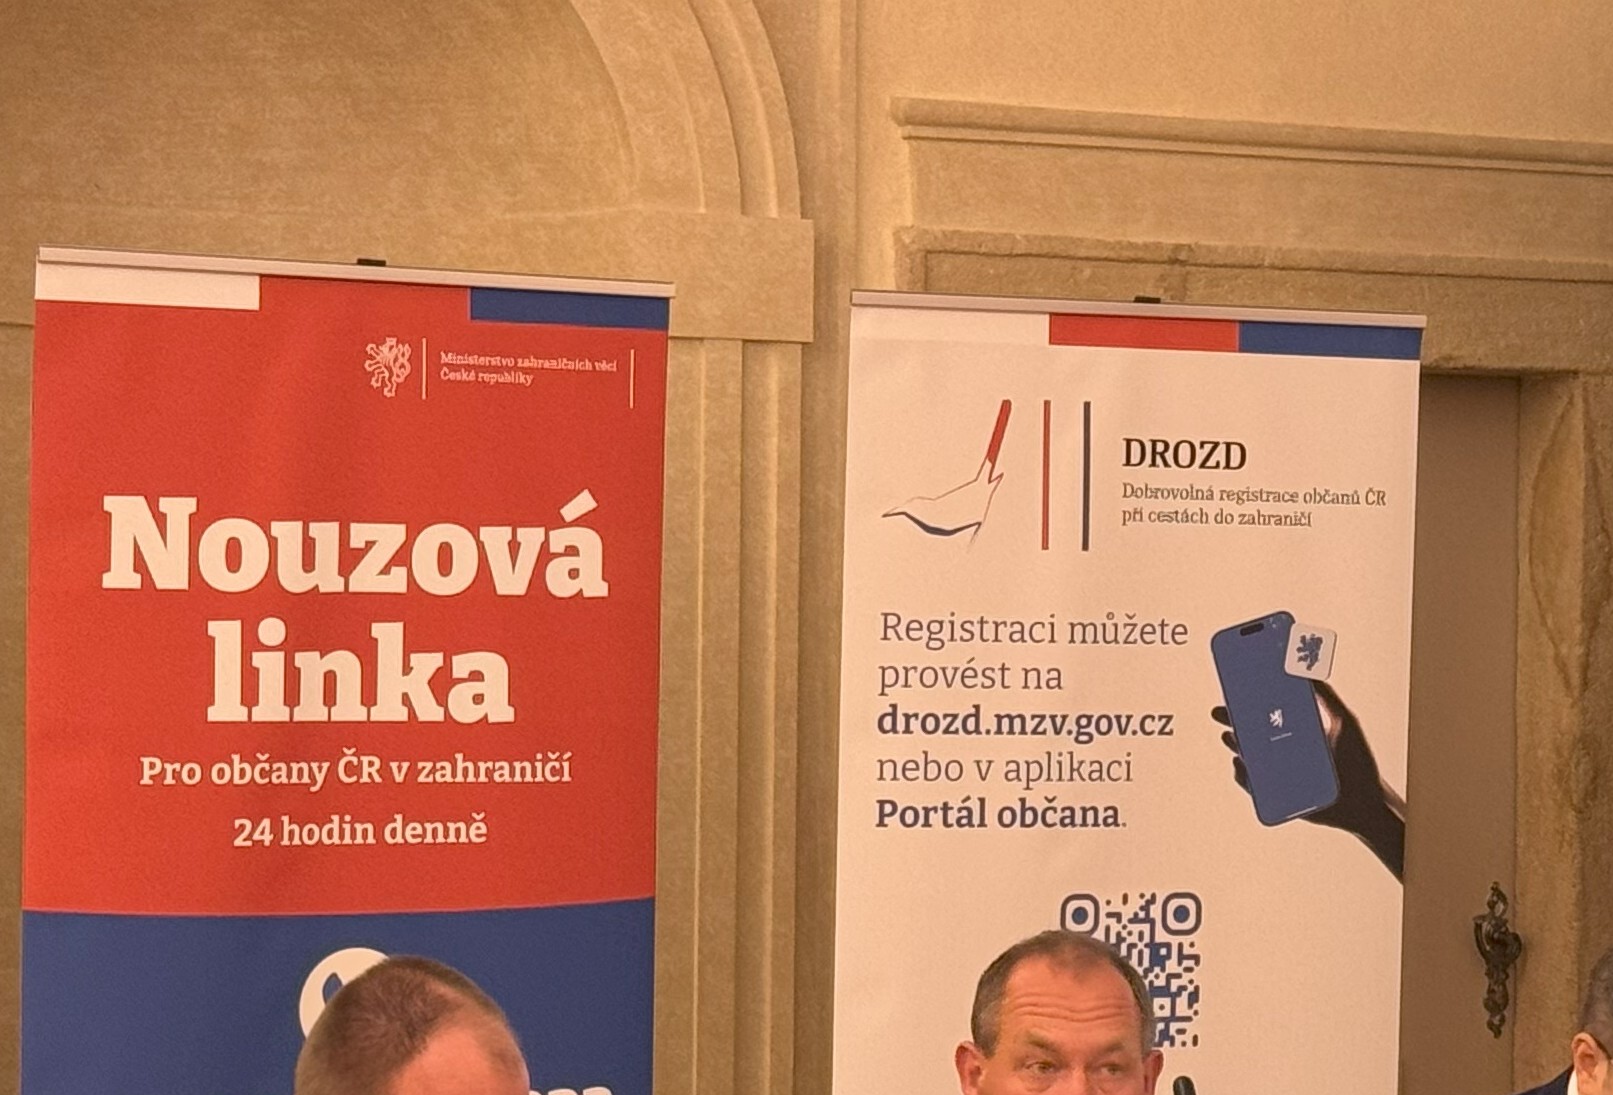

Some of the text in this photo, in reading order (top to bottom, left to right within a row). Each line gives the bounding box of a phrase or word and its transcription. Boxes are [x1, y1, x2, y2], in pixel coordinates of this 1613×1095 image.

[440, 350, 515, 368] Ministerstvo
[440, 366, 534, 386] České republiky
[1121, 437, 1247, 470] DROZD
[1121, 482, 1387, 506] Dobrovolná registrace občanů ČR
[1121, 507, 1313, 528] při cestách do zahraničí
[102, 488, 609, 598] Nouzová
[879, 611, 1189, 650] Registraci můžete
[206, 617, 516, 723] linka
[878, 657, 1063, 697] provést na
[877, 703, 1175, 745] drozd.mzv.gov.cz
[140, 747, 573, 793] Pro občany ČR v zahraničí
[876, 750, 1133, 791] nebo v aplikaci
[233, 812, 488, 847] 24 hodin denně
[875, 797, 1128, 829] Portál občana.
